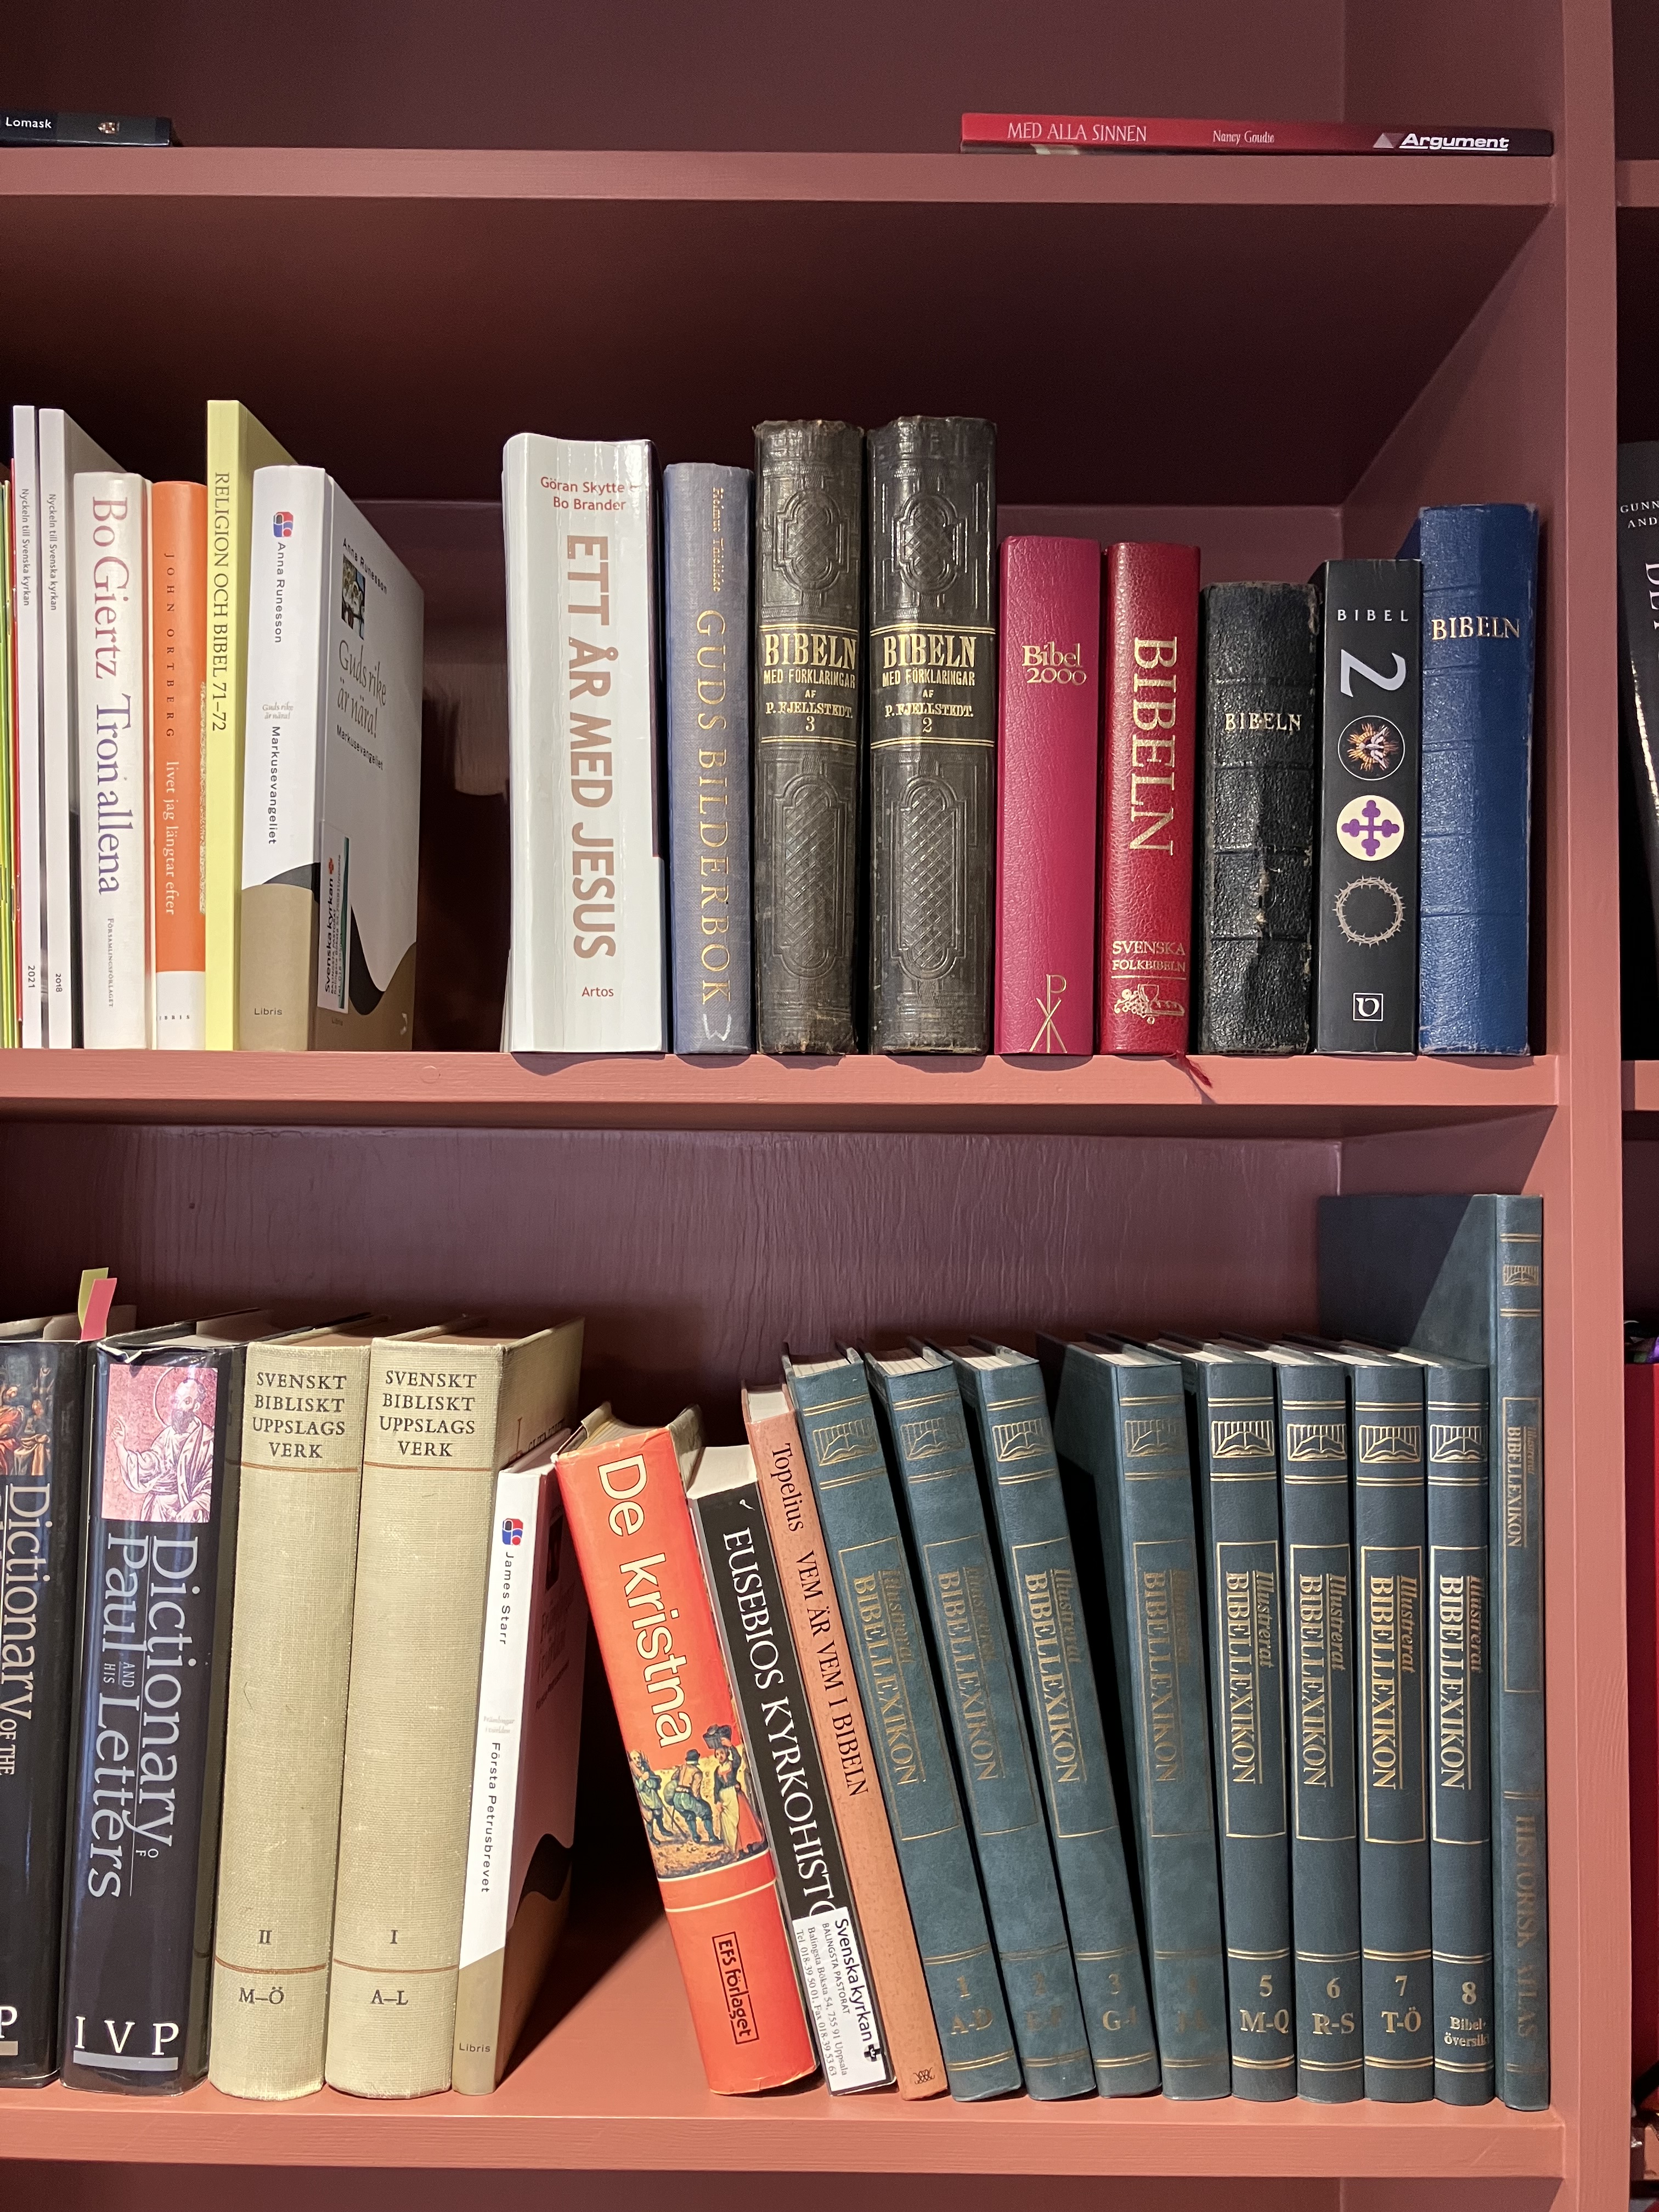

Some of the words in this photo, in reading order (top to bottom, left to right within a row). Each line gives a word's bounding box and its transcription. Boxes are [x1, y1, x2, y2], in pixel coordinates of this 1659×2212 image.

[5, 117, 52, 129] Lomask
[1007, 122, 1042, 139] MED
[1047, 123, 1088, 140] ALLA
[1092, 124, 1147, 143] SINNEN
[1212, 130, 1241, 145] Nancy
[1400, 133, 1510, 150] Argument
[540, 476, 578, 493] Göran
[583, 481, 625, 496] Skytte
[20, 488, 29, 523] Nyckeln
[47, 494, 57, 528] Nyckeln
[215, 471, 230, 567] RELIGION
[553, 496, 569, 509] Bo
[573, 498, 627, 511] Brander
[22, 524, 30, 537] till
[49, 529, 58, 542] till
[92, 496, 128, 547] Bo
[22, 538, 30, 574] Svenska
[49, 543, 58, 579] Svenska
[276, 541, 286, 575] Anna
[342, 538, 358, 562] Anna
[359, 556, 387, 595] Runesson
[21, 575, 32, 606] kyrkan
[49, 581, 58, 611] kyrkan
[165, 553, 174, 612] JOHN
[213, 574, 229, 618] OCH
[567, 535, 610, 626] ETT
[93, 556, 129, 679] Giertz
[274, 579, 285, 643] Runesson
[1336, 609, 1409, 622] BIBEL
[1431, 615, 1520, 641] BIBELN
[212, 624, 228, 677] BIBEL
[764, 633, 857, 670] BIBELN
[883, 633, 977, 669] BIBELN
[1022, 641, 1083, 668] Bibel
[166, 629, 175, 737] ORTBERG
[338, 639, 367, 688] Guds
[368, 661, 387, 707] rike
[568, 636, 619, 701] ÅR
[696, 609, 727, 730] GUDS
[763, 669, 783, 685] MED
[788, 667, 856, 689] FÖRKLARINGAR
[882, 670, 901, 687] MED
[906, 667, 975, 686] FÖRKLARINGAR
[1026, 668, 1087, 686] 2000
[337, 676, 350, 713] är
[351, 693, 378, 739] nära!
[765, 702, 777, 714] P.
[804, 689, 816, 698] AF
[922, 689, 934, 698] AF
[805, 715, 815, 732] 3
[884, 704, 895, 718] P.
[922, 717, 933, 733] 2
[1224, 712, 1302, 734] BIBELN
[96, 693, 132, 786] Tron
[336, 724, 384, 771] Markusevangeliet
[1129, 636, 1178, 856] BIBELN
[569, 712, 614, 808] MED
[166, 761, 179, 794] livet
[268, 726, 281, 844] Markusevangeliet
[163, 798, 178, 821] jag
[98, 791, 133, 895] allena
[162, 826, 179, 878] längtar
[571, 821, 617, 959] JESUS
[698, 748, 731, 1006] BILDERBOK
[166, 882, 179, 915] efter
[1111, 940, 1186, 956] SVENSKA
[1111, 960, 1186, 972] FOLKBIBELN
[581, 986, 614, 998] Artos
[256, 1372, 347, 1390] SVENSKT
[385, 1370, 478, 1389] SVENSKT
[254, 1394, 346, 1413] BIBLISKT
[382, 1393, 476, 1412] BIBLISKT
[252, 1417, 346, 1435] UPPSLAGS
[379, 1415, 476, 1434] UPPSLAGS
[268, 1442, 323, 1459] VERK
[398, 1441, 453, 1457] VERK
[597, 1454, 648, 1537] De
[771, 1442, 805, 1532] Topelius
[1506, 1426, 1522, 1548] BIBELLEXIKON
[502, 1552, 515, 1599] James
[795, 1549, 823, 1601] VEM
[0, 1483, 53, 1720] Dictionary
[103, 1532, 149, 1652] Paul
[723, 1527, 785, 1690] EUSEBIOS
[499, 1605, 511, 1645] Starr
[806, 1605, 832, 1638] ÄR
[1256, 1571, 1274, 1669] Illustrerat
[1329, 1574, 1347, 1672] Illustrerat
[1401, 1574, 1417, 1674] Illustrerat
[619, 1553, 693, 1748] kristna
[816, 1640, 844, 1692] VEM
[103, 1663, 116, 1684] HIS
[121, 1661, 136, 1689] AND
[853, 1573, 919, 1785] BIBELLEXIKON
[938, 1571, 998, 1782] BIBELLEXIKON
[1025, 1571, 1080, 1783] BIBELLEXIKON
[1143, 1571, 1179, 1782] BIBELLEXIKON
[1225, 1571, 1256, 1785] BIBELLEXIKON
[1299, 1573, 1328, 1788] BIBELLEXIKON
[1370, 1575, 1397, 1791] BIBELLEXIKON
[1439, 1575, 1465, 1791] BIBELLEXIKON
[122, 1536, 201, 1847] Dictionary
[828, 1696, 849, 1710] I
[0, 1718, 18, 1741] OF
[489, 1742, 501, 1790] Första
[832, 1712, 869, 1797] BIBELN
[88, 1692, 140, 1898] Letters
[481, 1795, 498, 1893] Petrusbrevet
[258, 1929, 273, 1945] II
[390, 1929, 398, 1945] I
[716, 1938, 737, 1966] EFS
[808, 1926, 821, 1966] Balingsta
[800, 1946, 814, 1976] 018-39
[822, 1922, 839, 1970] BALINGSTA
[834, 1971, 850, 2015] PASTORAT
[816, 1966, 828, 1996] Böksta
[834, 1918, 860, 1985] Svenska
[849, 1984, 873, 2042] kyrkan
[957, 1975, 971, 1998] 1
[1108, 1973, 1122, 1996] 3
[1259, 1974, 1273, 1997] 5
[1326, 1977, 1341, 1999] 6
[1395, 1974, 1408, 1997] 7
[1461, 1981, 1477, 2005] 8
[725, 1967, 752, 2038] förlaget
[813, 2005, 822, 2021] Fax
[74, 2016, 180, 2056] IVP
[827, 2011, 838, 2028] 755
[832, 2029, 840, 2040] 91
[1239, 2008, 1290, 2034] M-Q
[1312, 2012, 1355, 2035] R-S
[1381, 2006, 1422, 2034] T-Ö
[459, 2042, 491, 2053] Libris
[818, 2022, 831, 2051] 018-39
[825, 2052, 834, 2064] 53
[828, 2065, 837, 2076] 63
[833, 2042, 848, 2076] Uppsala
